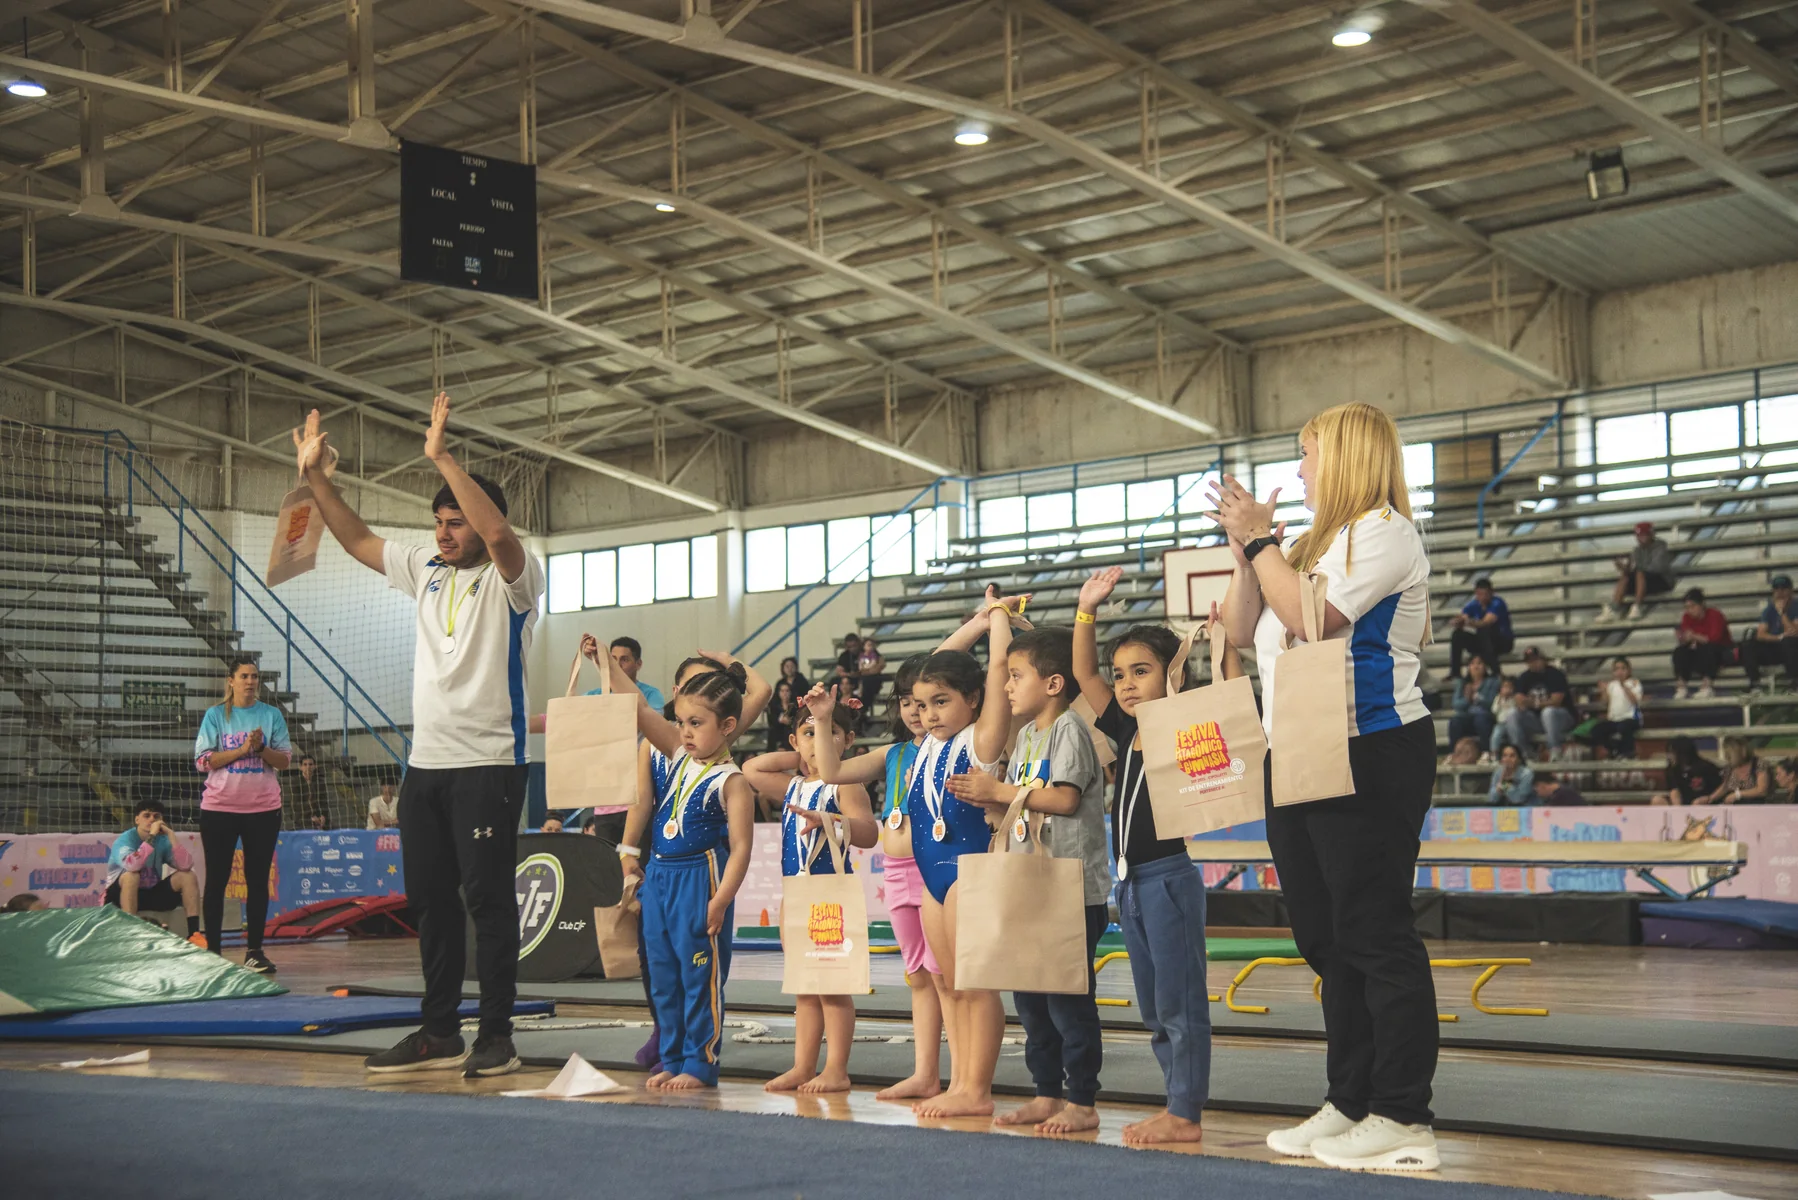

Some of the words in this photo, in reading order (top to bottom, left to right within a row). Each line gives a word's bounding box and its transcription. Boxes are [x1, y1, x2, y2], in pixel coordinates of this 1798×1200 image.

[461, 156, 488, 169] TIEMPO
[431, 188, 457, 201] LOCAL
[491, 198, 514, 212] VISITA
[459, 223, 486, 234] PERIODO
[432, 237, 454, 248] FALTAS
[493, 248, 515, 258] FALTAS
[1175, 721, 1220, 748] FESTIVAL
[1183, 750, 1228, 775] GIMNASIA
[1196, 774, 1244, 790] ENTRENAMIENTO
